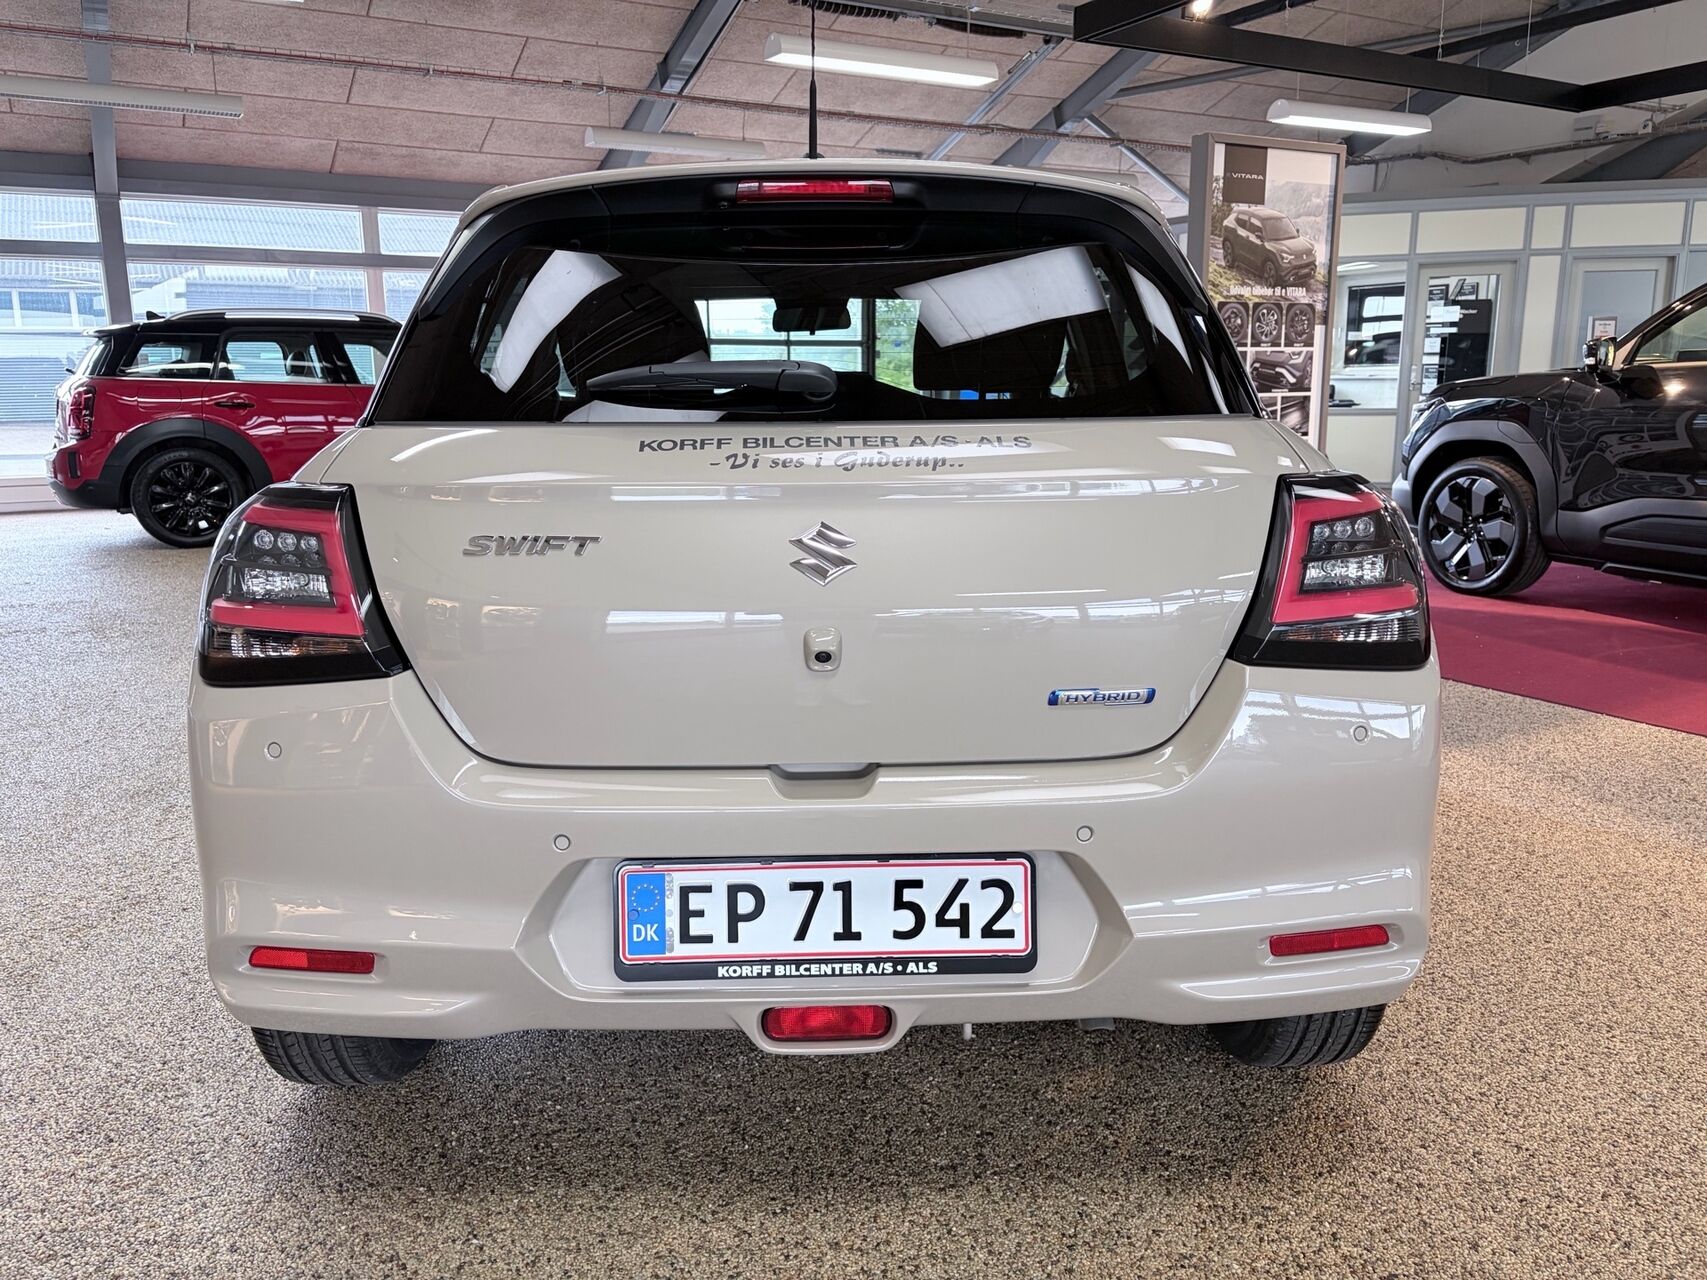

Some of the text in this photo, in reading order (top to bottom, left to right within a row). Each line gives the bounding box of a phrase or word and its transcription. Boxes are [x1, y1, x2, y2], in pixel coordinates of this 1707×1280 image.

[1231, 172, 1264, 180] VITARA
[1286, 286, 1307, 297] VITARA
[638, 437, 734, 453] KORFF
[742, 435, 900, 450] BILCENTER
[769, 456, 805, 469] ses
[814, 452, 823, 468] i
[463, 535, 601, 557] SWIFT
[1065, 691, 1141, 703] HYBRID
[677, 877, 1017, 945] EP 71 542
[632, 922, 660, 943] DK
[716, 961, 938, 978] KORFF BILCENTER A/S ALS
